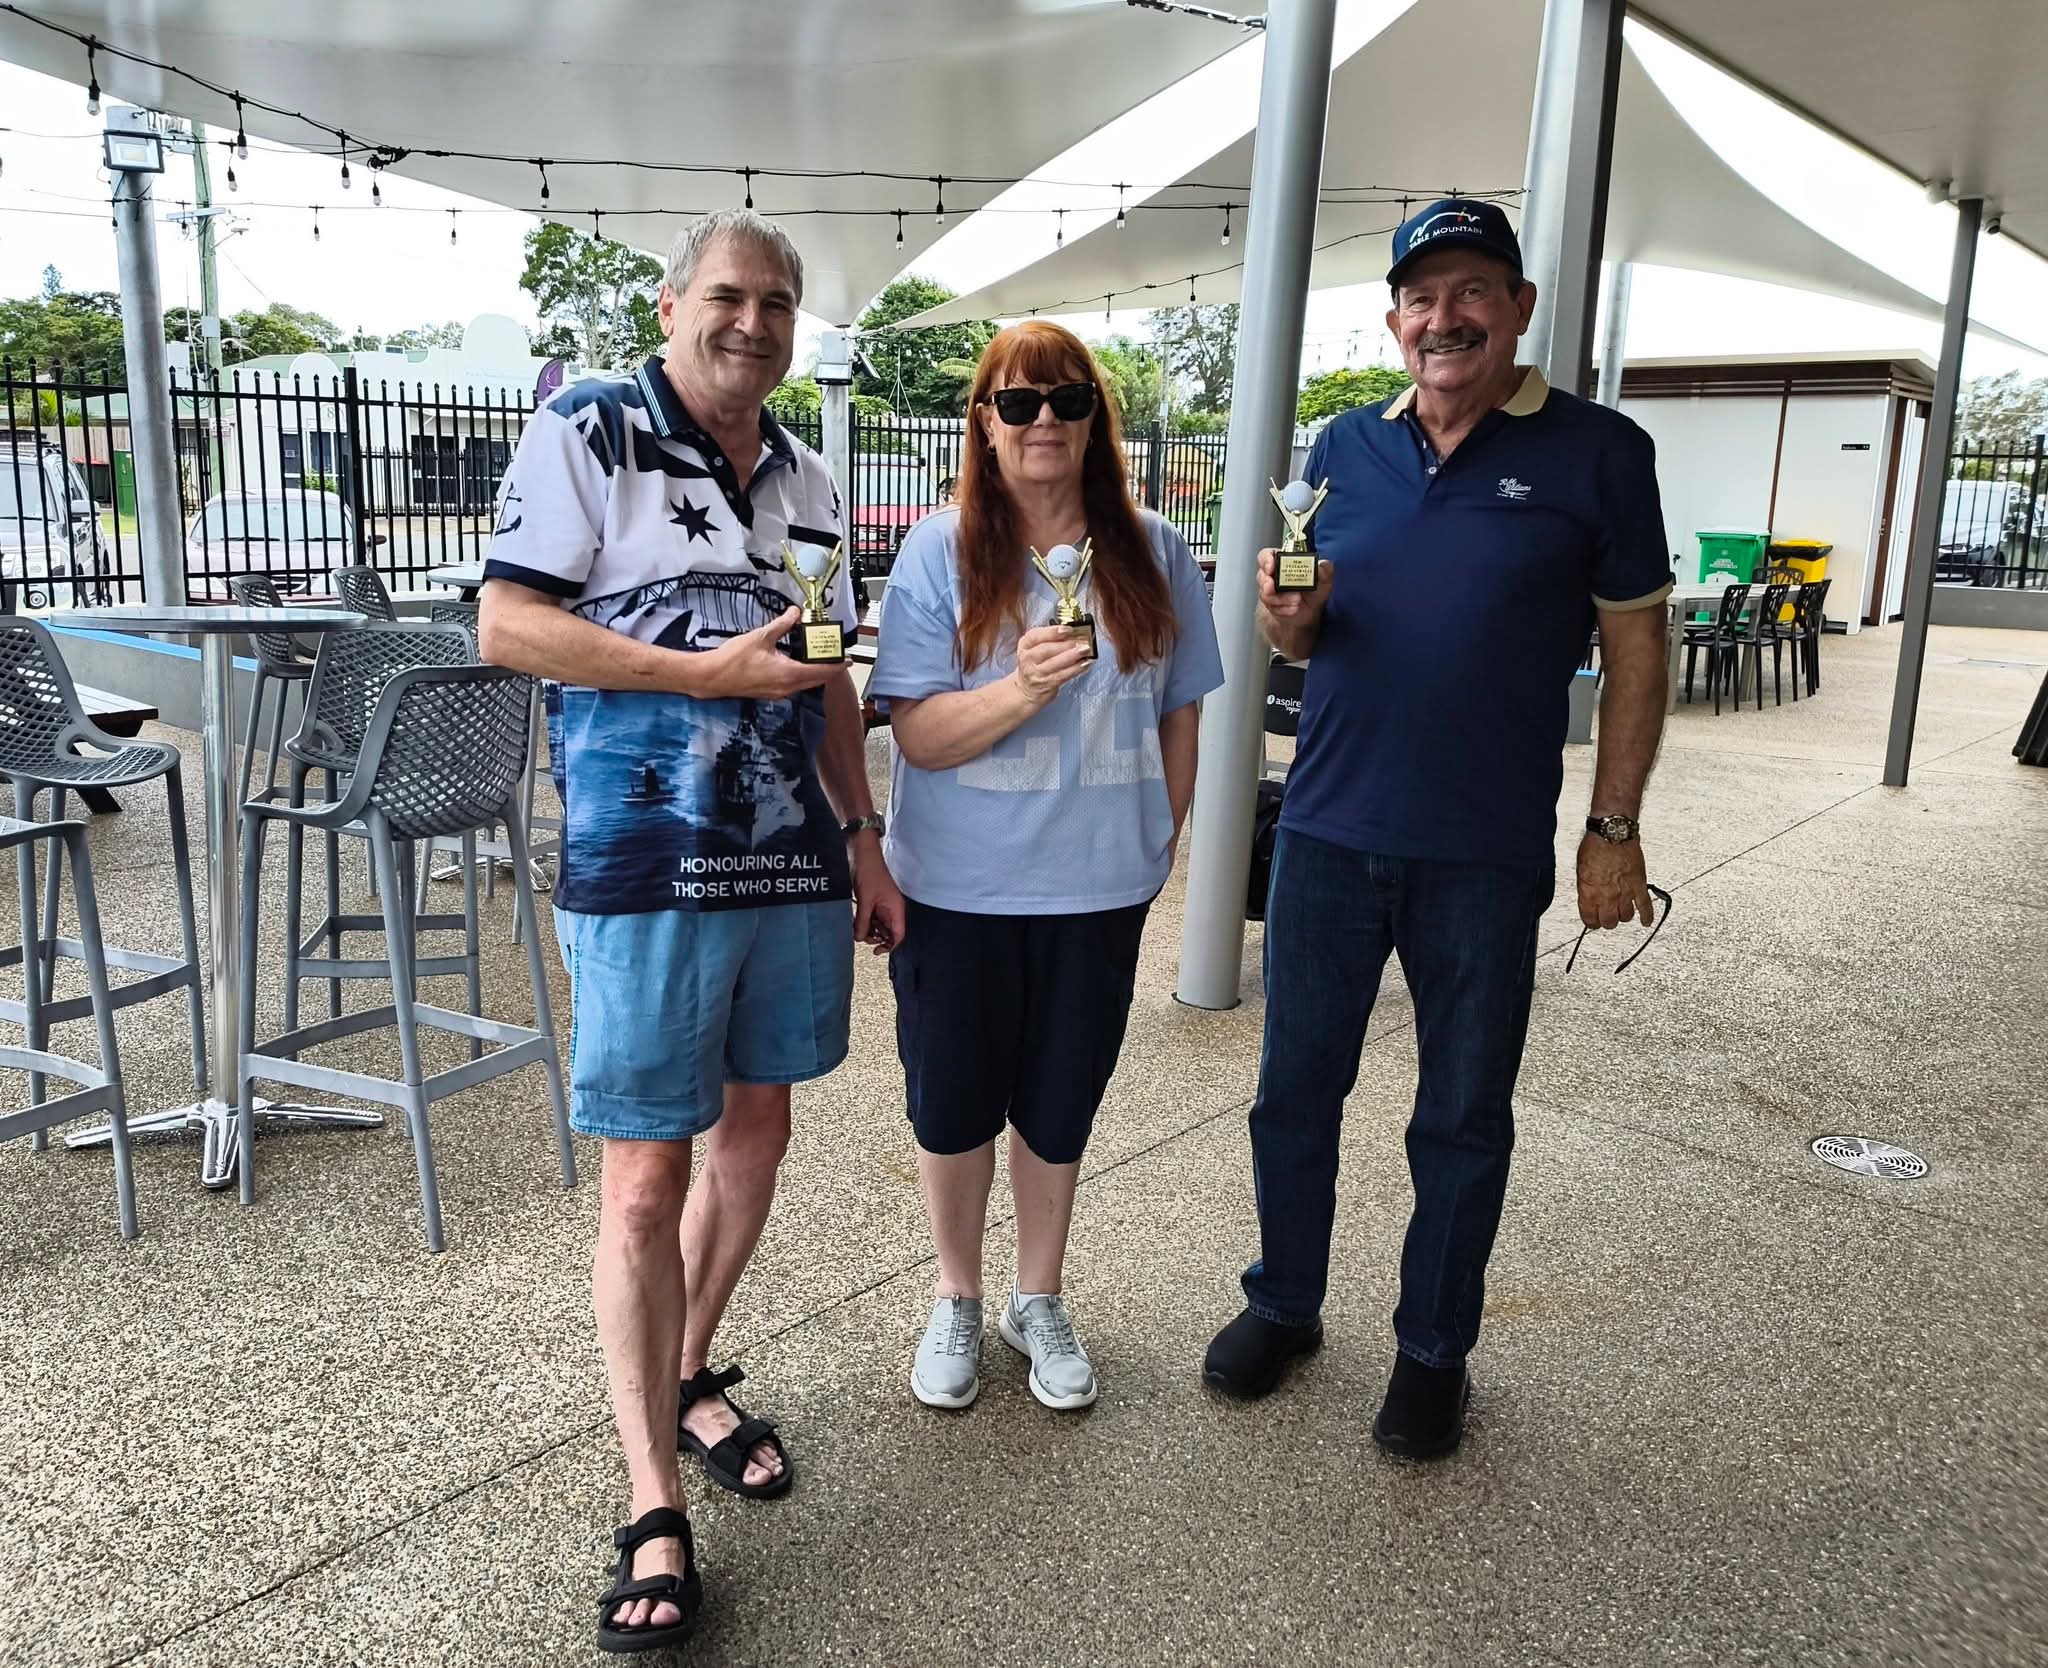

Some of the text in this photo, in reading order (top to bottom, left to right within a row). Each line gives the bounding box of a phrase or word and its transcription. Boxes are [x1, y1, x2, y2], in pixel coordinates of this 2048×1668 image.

[1409, 225, 1483, 250] TABLE MOUNTAIN
[1275, 698, 1302, 707] aspire
[680, 855, 822, 873] HONOURING ALL
[672, 877, 829, 898] THOSE WHO SERVE
